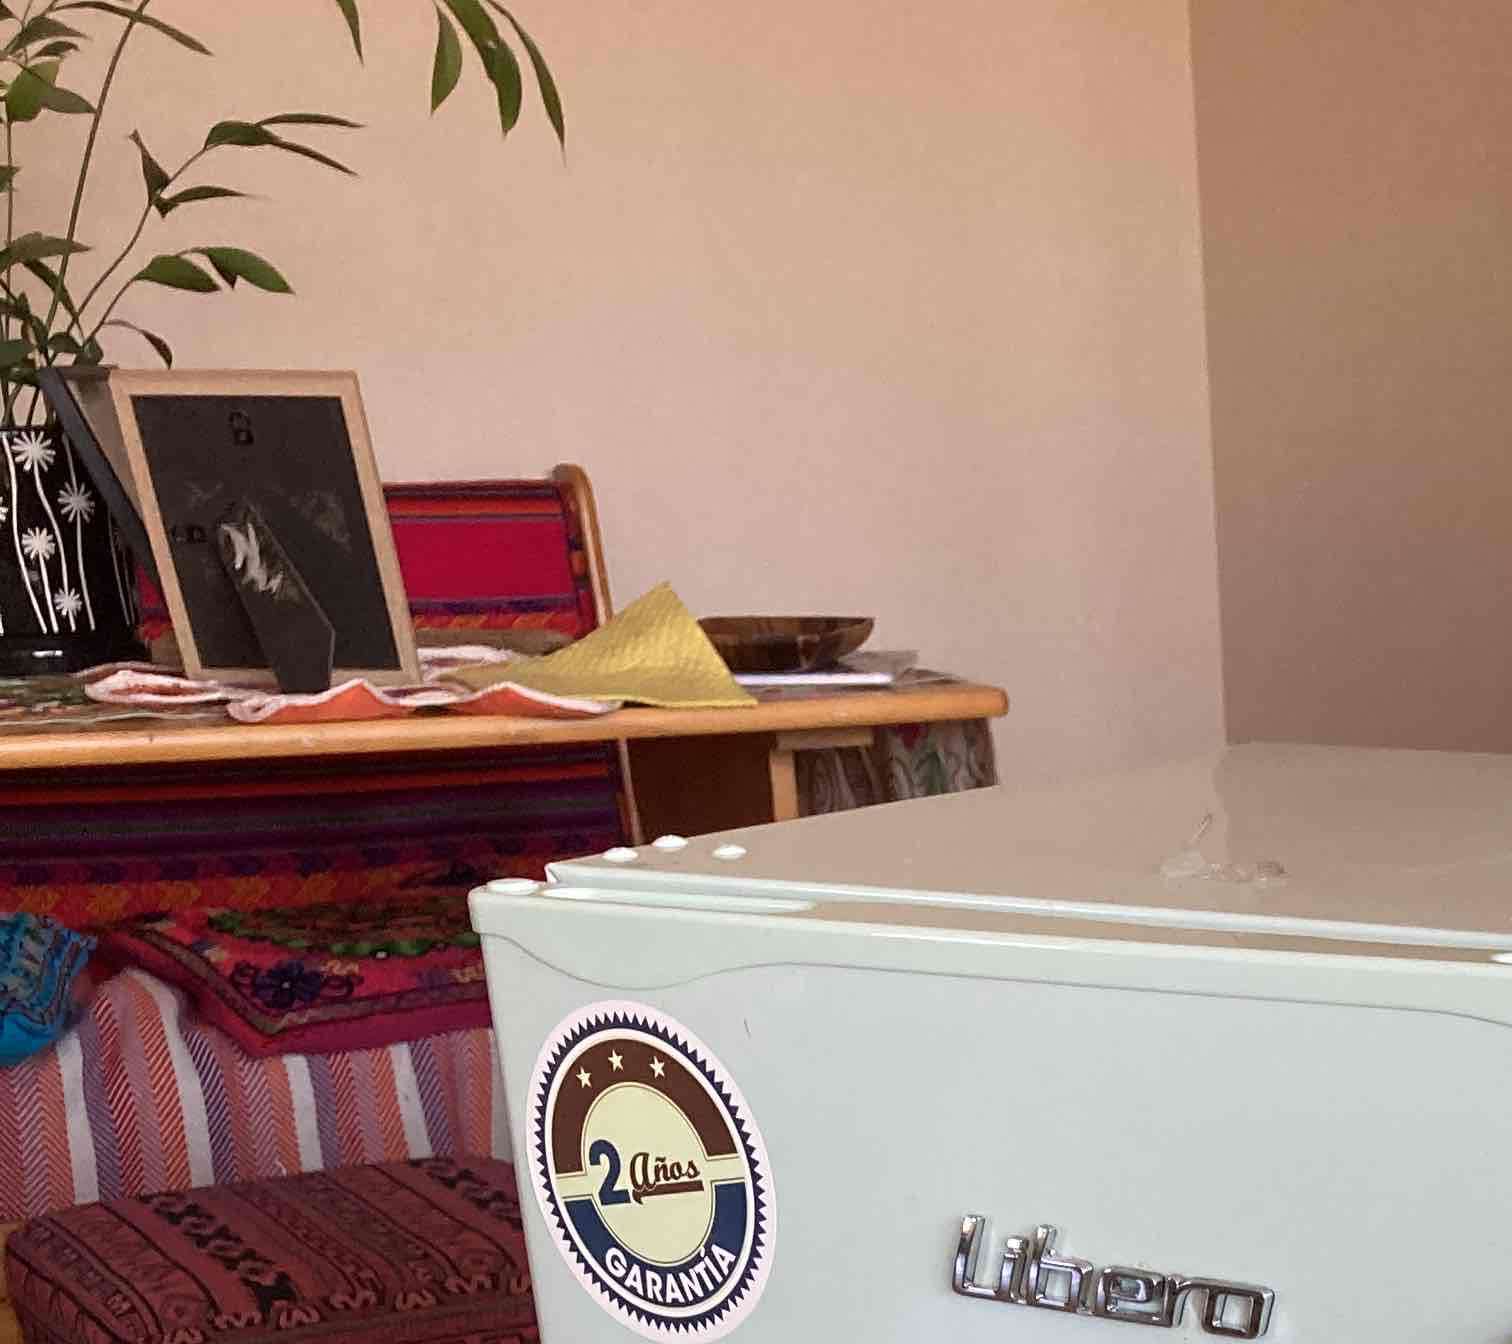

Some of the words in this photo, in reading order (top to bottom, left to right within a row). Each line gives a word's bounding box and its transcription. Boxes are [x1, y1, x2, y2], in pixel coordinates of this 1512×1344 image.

[588, 1139, 631, 1206] 2
[629, 1151, 700, 1192] Años
[605, 1244, 736, 1304] GARANTÍA
[952, 1214, 1276, 1339] Libero
